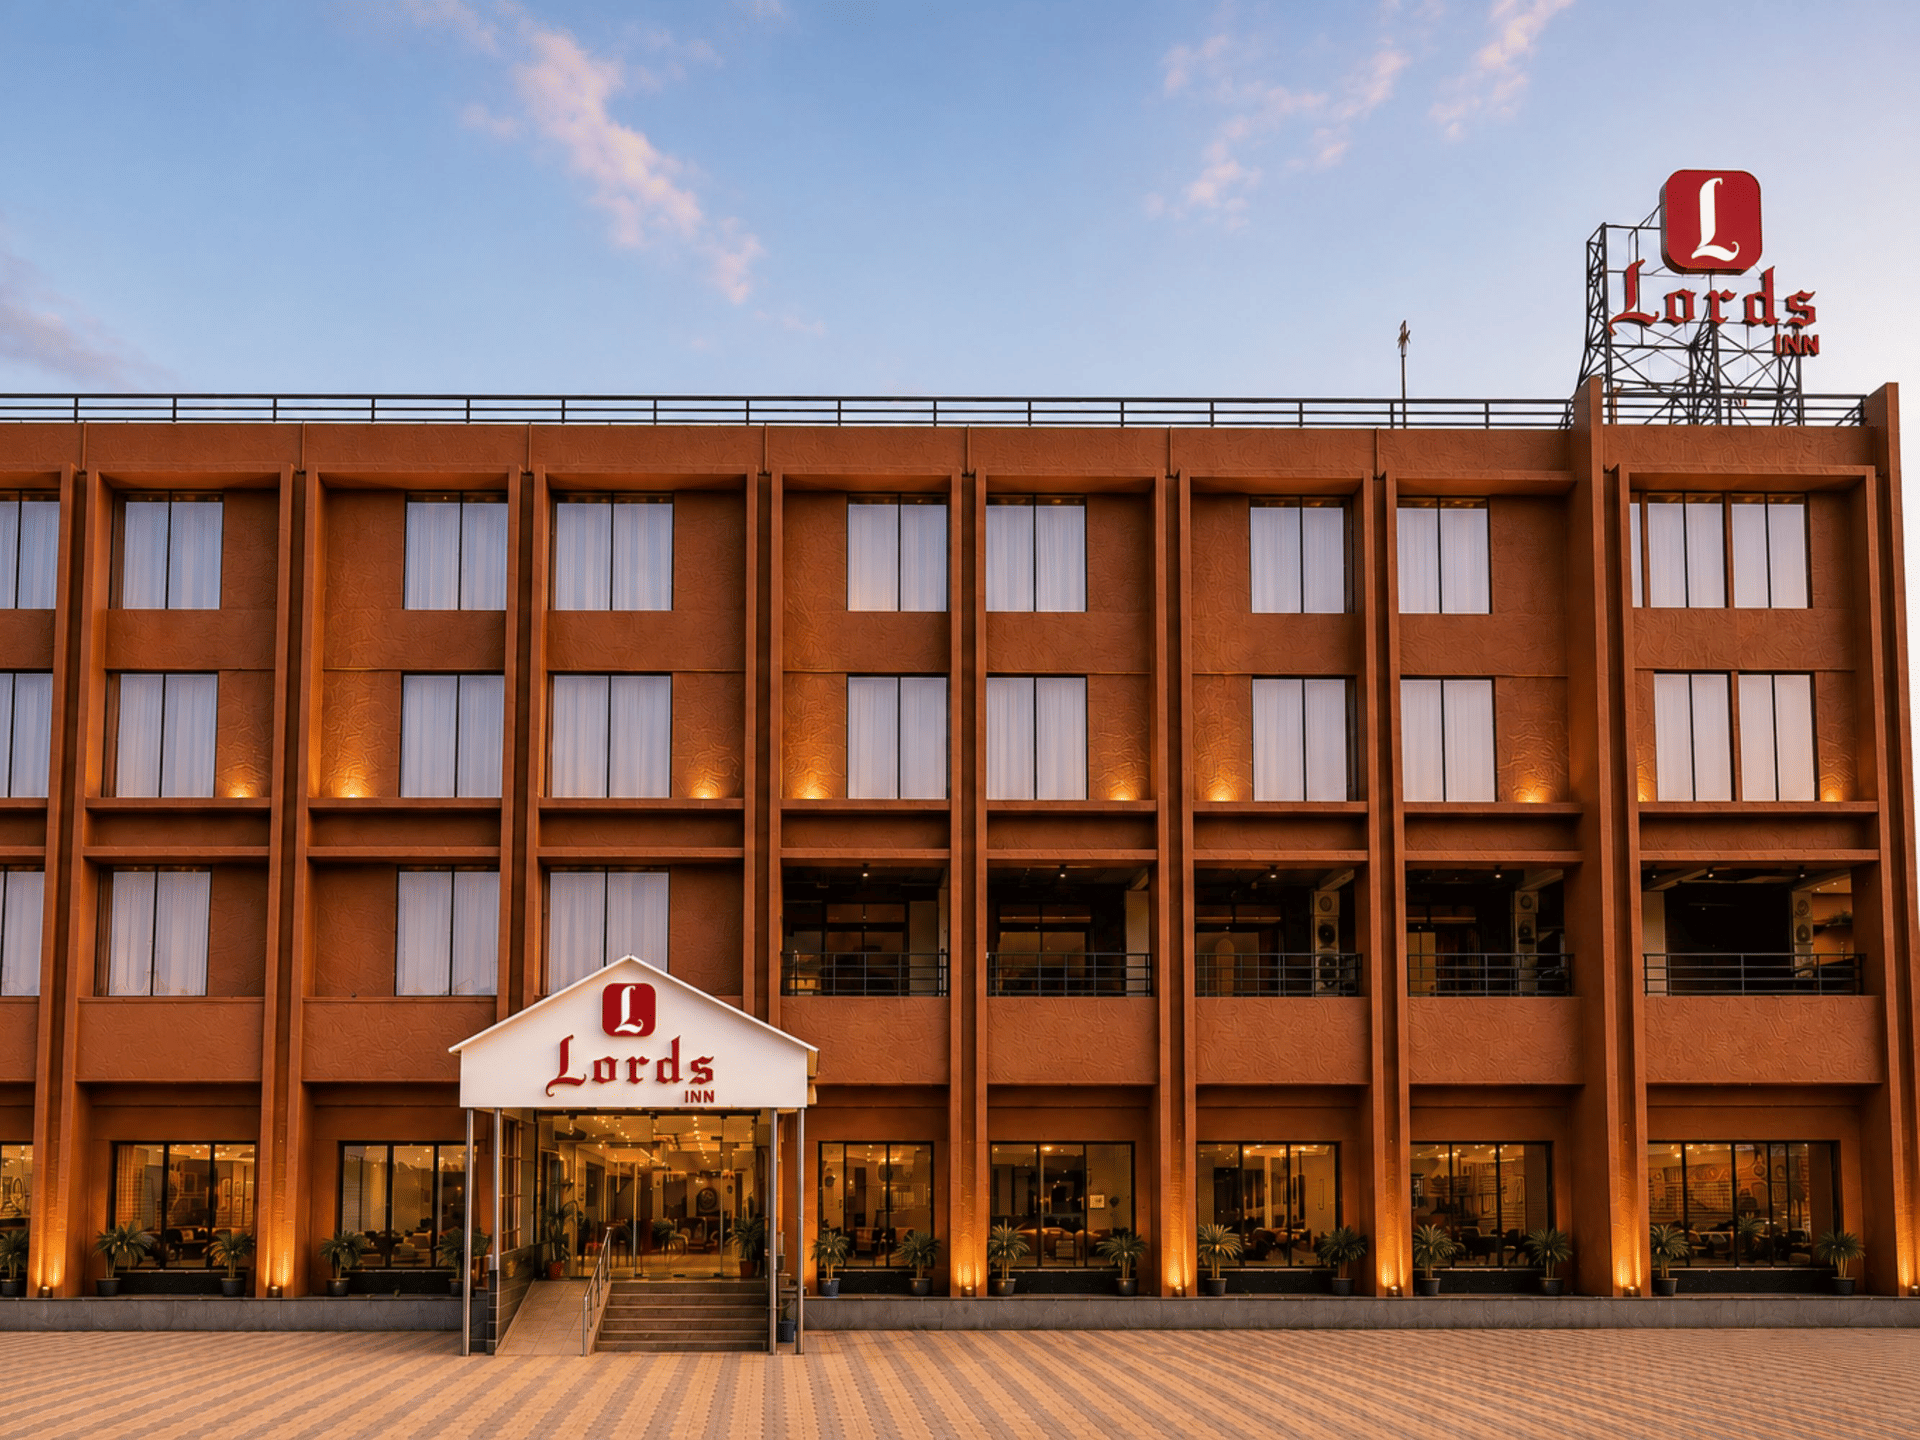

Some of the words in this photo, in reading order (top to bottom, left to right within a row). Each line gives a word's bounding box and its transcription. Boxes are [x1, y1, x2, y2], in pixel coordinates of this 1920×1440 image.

[1691, 177, 1740, 262] L
[1607, 258, 1817, 336] Lords
[1774, 333, 1820, 357] INN
[614, 985, 644, 1034] L
[545, 1034, 715, 1097] Lords
[684, 1089, 715, 1103] INN
